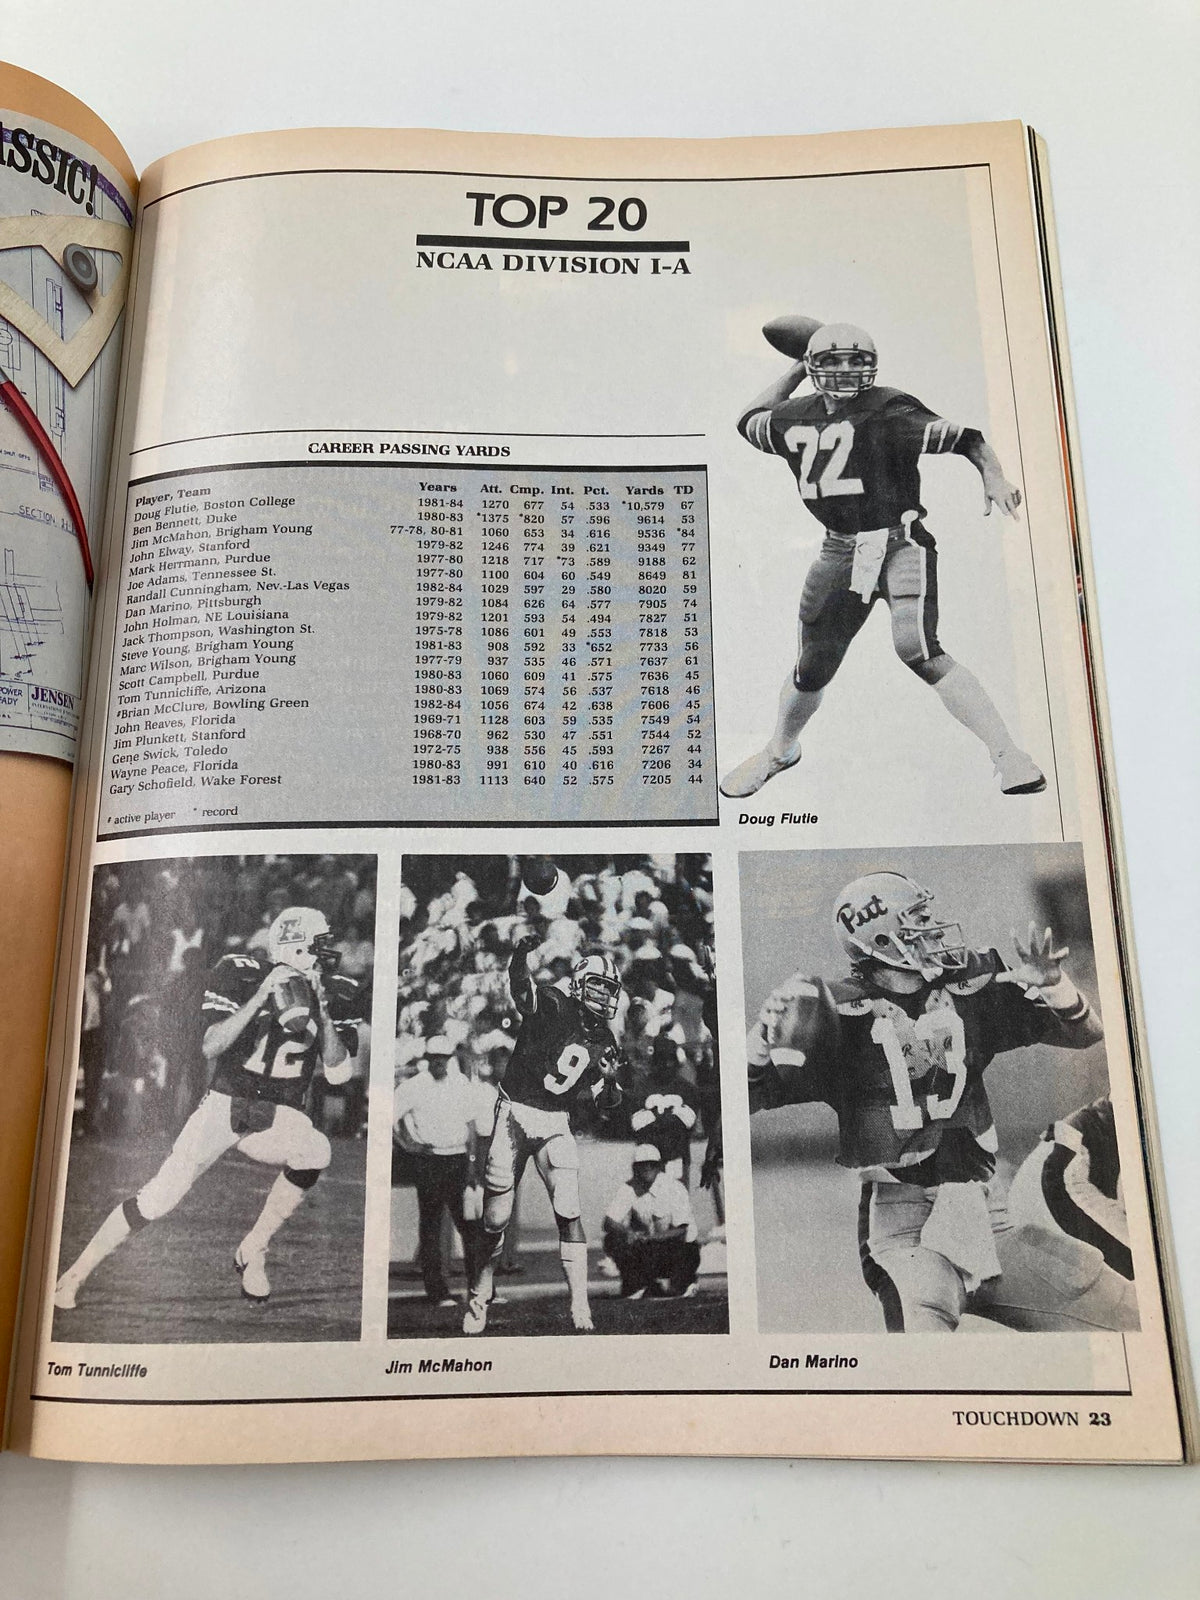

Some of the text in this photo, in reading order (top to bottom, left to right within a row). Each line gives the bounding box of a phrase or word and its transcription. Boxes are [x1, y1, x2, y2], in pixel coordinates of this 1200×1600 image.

[0, 122, 98, 215] SSIC!
[466, 192, 647, 232] TOP 20
[416, 252, 691, 274] NCAA DIVISION I-A
[308, 443, 510, 457] CAREER PASSING YARDS
[784, 420, 865, 499] 22
[419, 482, 694, 497] Years Att. Cmp. Int. Pct. Yards TD
[136, 488, 210, 509] Player, Team
[418, 498, 463, 508] 1981-84
[134, 496, 295, 522] Doug Flutie, Boston College
[418, 511, 463, 522] 1980-83
[637, 515, 664, 524] 9614
[133, 513, 237, 536] Ben Bennett, Duke
[131, 524, 312, 549] Jim McMahon, Brigham Young
[390, 526, 462, 536] 77-78, 80-81
[638, 529, 665, 540] 9536
[416, 540, 463, 550] 1979-82
[638, 543, 665, 554] 9349
[130, 539, 250, 563] John Elway, Stanford
[417, 554, 463, 564] 1977-80
[638, 557, 666, 566] 9188
[129, 553, 270, 577] Mark Herrmann, Purdue
[417, 568, 463, 578] 1977-80
[638, 571, 666, 580] 8649
[127, 567, 276, 591] Joe Adams, Tennessee St.
[417, 582, 463, 592] 1982-84
[638, 585, 666, 594] 8020
[126, 581, 350, 608] Randall Cunningham, Nev.-Las Vegas
[125, 595, 261, 619] Dan Marino, Pittsburgh
[416, 597, 463, 607] 1979-82
[639, 599, 666, 608] 7905
[124, 608, 289, 633] John Holman, NE Louisiana
[416, 611, 462, 621] 1979-82
[639, 614, 667, 623] 7827
[122, 624, 314, 647] Jack Thompson, Washington St.
[416, 626, 462, 636] 1975-78
[639, 628, 668, 639] 7818
[121, 639, 294, 661] Steve Young, Brigham Young
[416, 640, 462, 650] 1981-83
[640, 642, 668, 652] 7733
[120, 654, 296, 676] Marc Wilson, Brigham Young
[416, 655, 462, 665] 1977-79
[640, 656, 668, 666] 7637
[119, 668, 259, 690] Scott Campbell, Purdue
[415, 670, 462, 680] 1980-83
[640, 671, 669, 681] 7636
[118, 684, 266, 705] Tom Tunnicliffe, Arizona
[414, 684, 462, 694] 1980-83
[641, 686, 669, 697] 7618
[31, 687, 74, 710] JENSEN
[414, 699, 461, 709] 1982-84
[154, 702, 207, 715] McClure,
[212, 698, 266, 711] Bowling
[270, 698, 309, 708] Green
[641, 699, 670, 710] 7606
[414, 714, 460, 724] 1969-71
[641, 714, 670, 725] 7549
[114, 714, 236, 736] John Reaves, Florida
[113, 728, 246, 750] Jim Plunkett, Stanford
[414, 729, 461, 740] 1968-70
[642, 729, 670, 740] 7544
[112, 744, 228, 765] Gene Swick, Toledo
[413, 744, 460, 754] 1972-75
[642, 744, 670, 755] 7267
[111, 759, 238, 780] Wayne Peace, Florida
[412, 760, 460, 770] 1980-83
[642, 759, 671, 770] 7206
[413, 774, 460, 785] 1981-83
[642, 775, 671, 784] 7205
[110, 775, 282, 796] Gary Schofield, Wake Forest
[202, 806, 238, 816] record
[114, 812, 176, 824] active player
[739, 813, 818, 826] Doug Flutie
[837, 894, 888, 934] Pitt
[243, 1034, 310, 1079] 12
[543, 1043, 591, 1095] 9
[871, 1009, 967, 1129] 13
[385, 1358, 492, 1374] Jim McMahon
[769, 1354, 858, 1368] Dan Marino
[48, 1362, 147, 1378] Tom Tunnicliffe
[952, 1411, 1112, 1426] TOUCHDOWN 23
